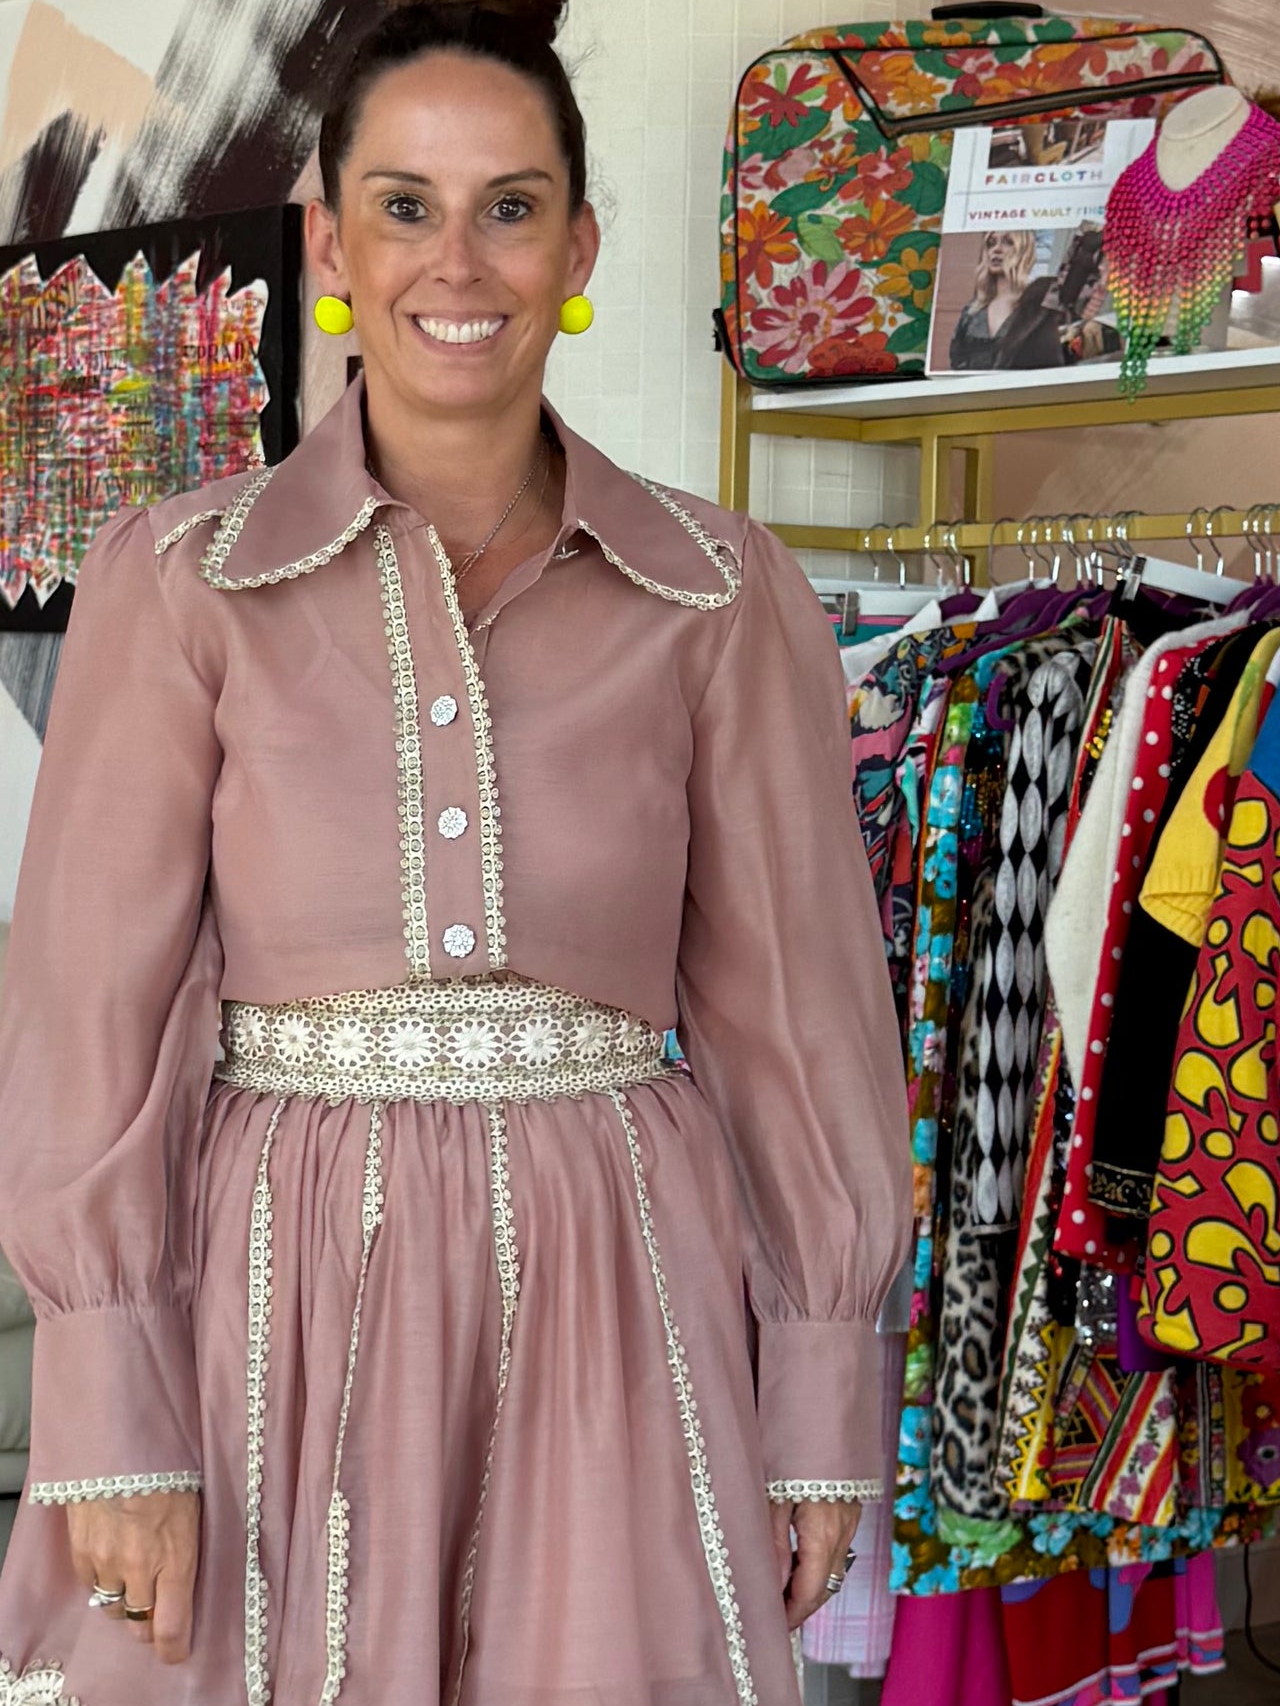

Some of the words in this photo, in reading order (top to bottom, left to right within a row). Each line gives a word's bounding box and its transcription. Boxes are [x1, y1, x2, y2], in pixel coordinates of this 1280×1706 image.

[984, 169, 1104, 186] FAIRCLOTH
[969, 208, 1027, 221] VINTAGE
[1031, 207, 1071, 219] VAULT
